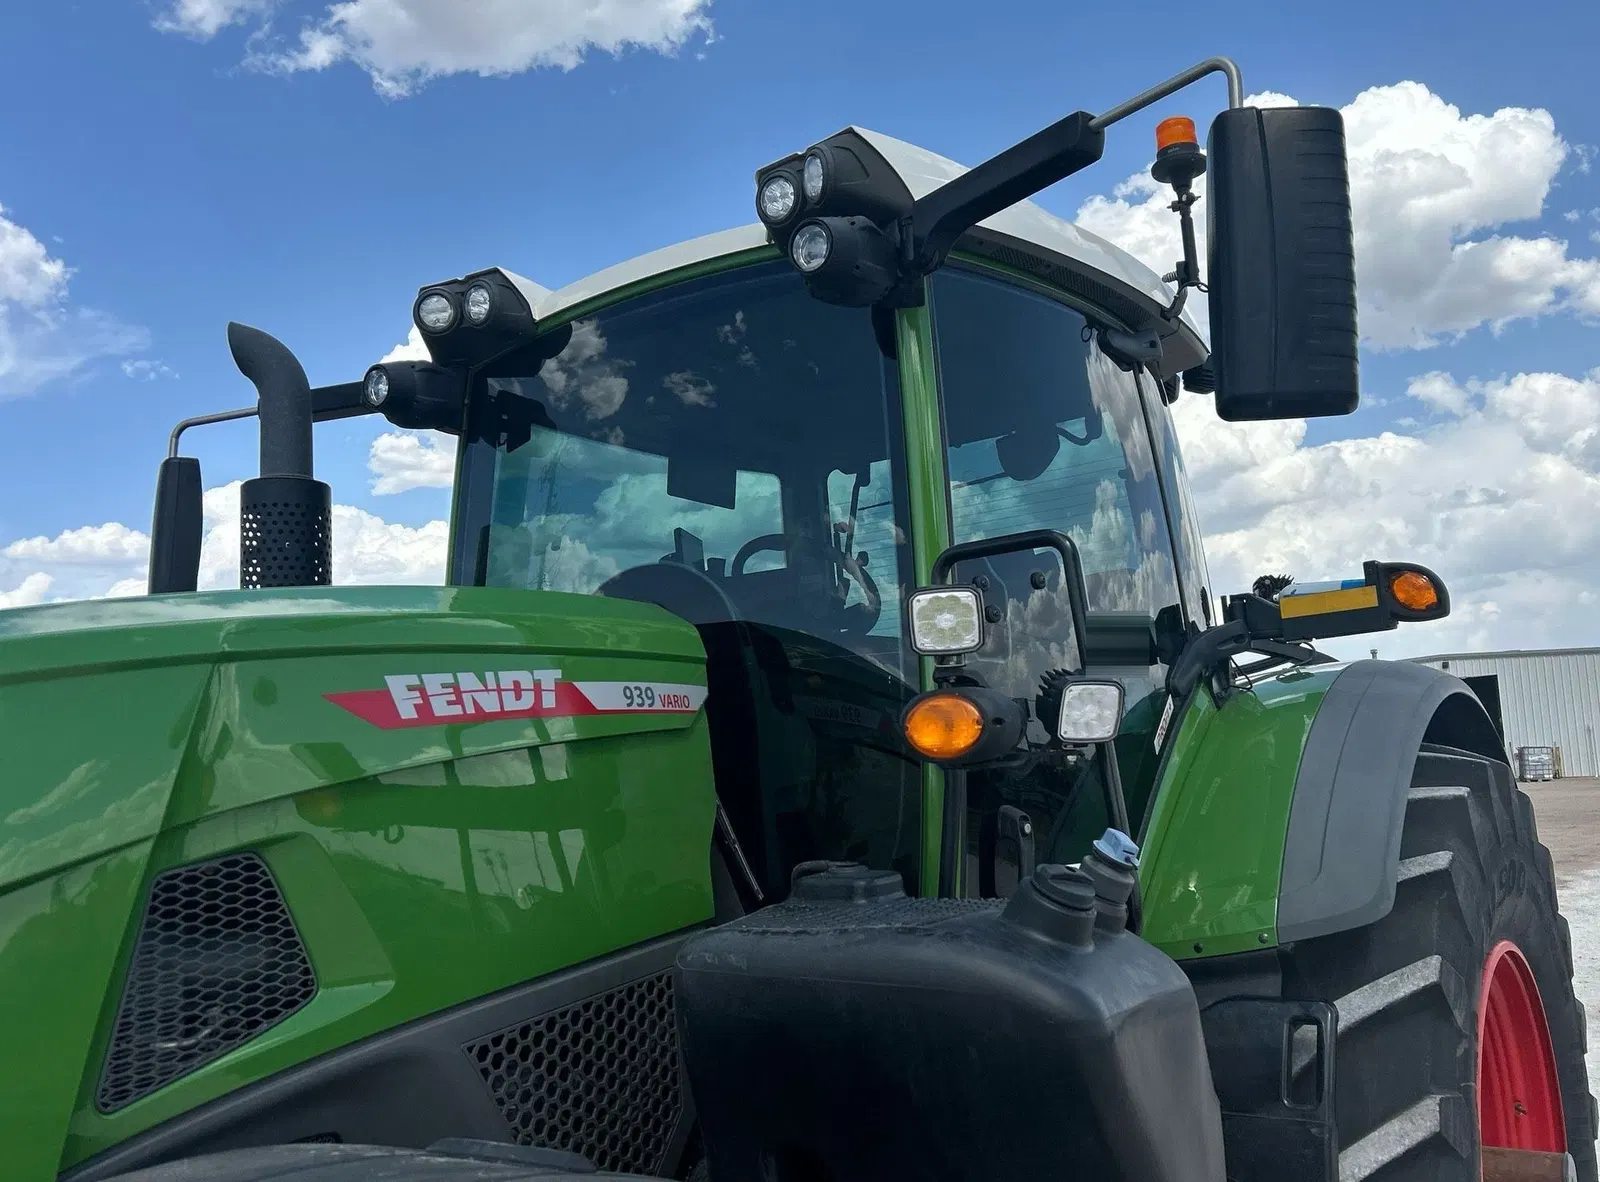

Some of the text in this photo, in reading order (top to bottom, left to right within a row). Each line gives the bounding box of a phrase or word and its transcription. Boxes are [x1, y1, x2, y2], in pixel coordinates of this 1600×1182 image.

[384, 669, 562, 719] FENDT
[622, 685, 691, 710] 939 VARIO
